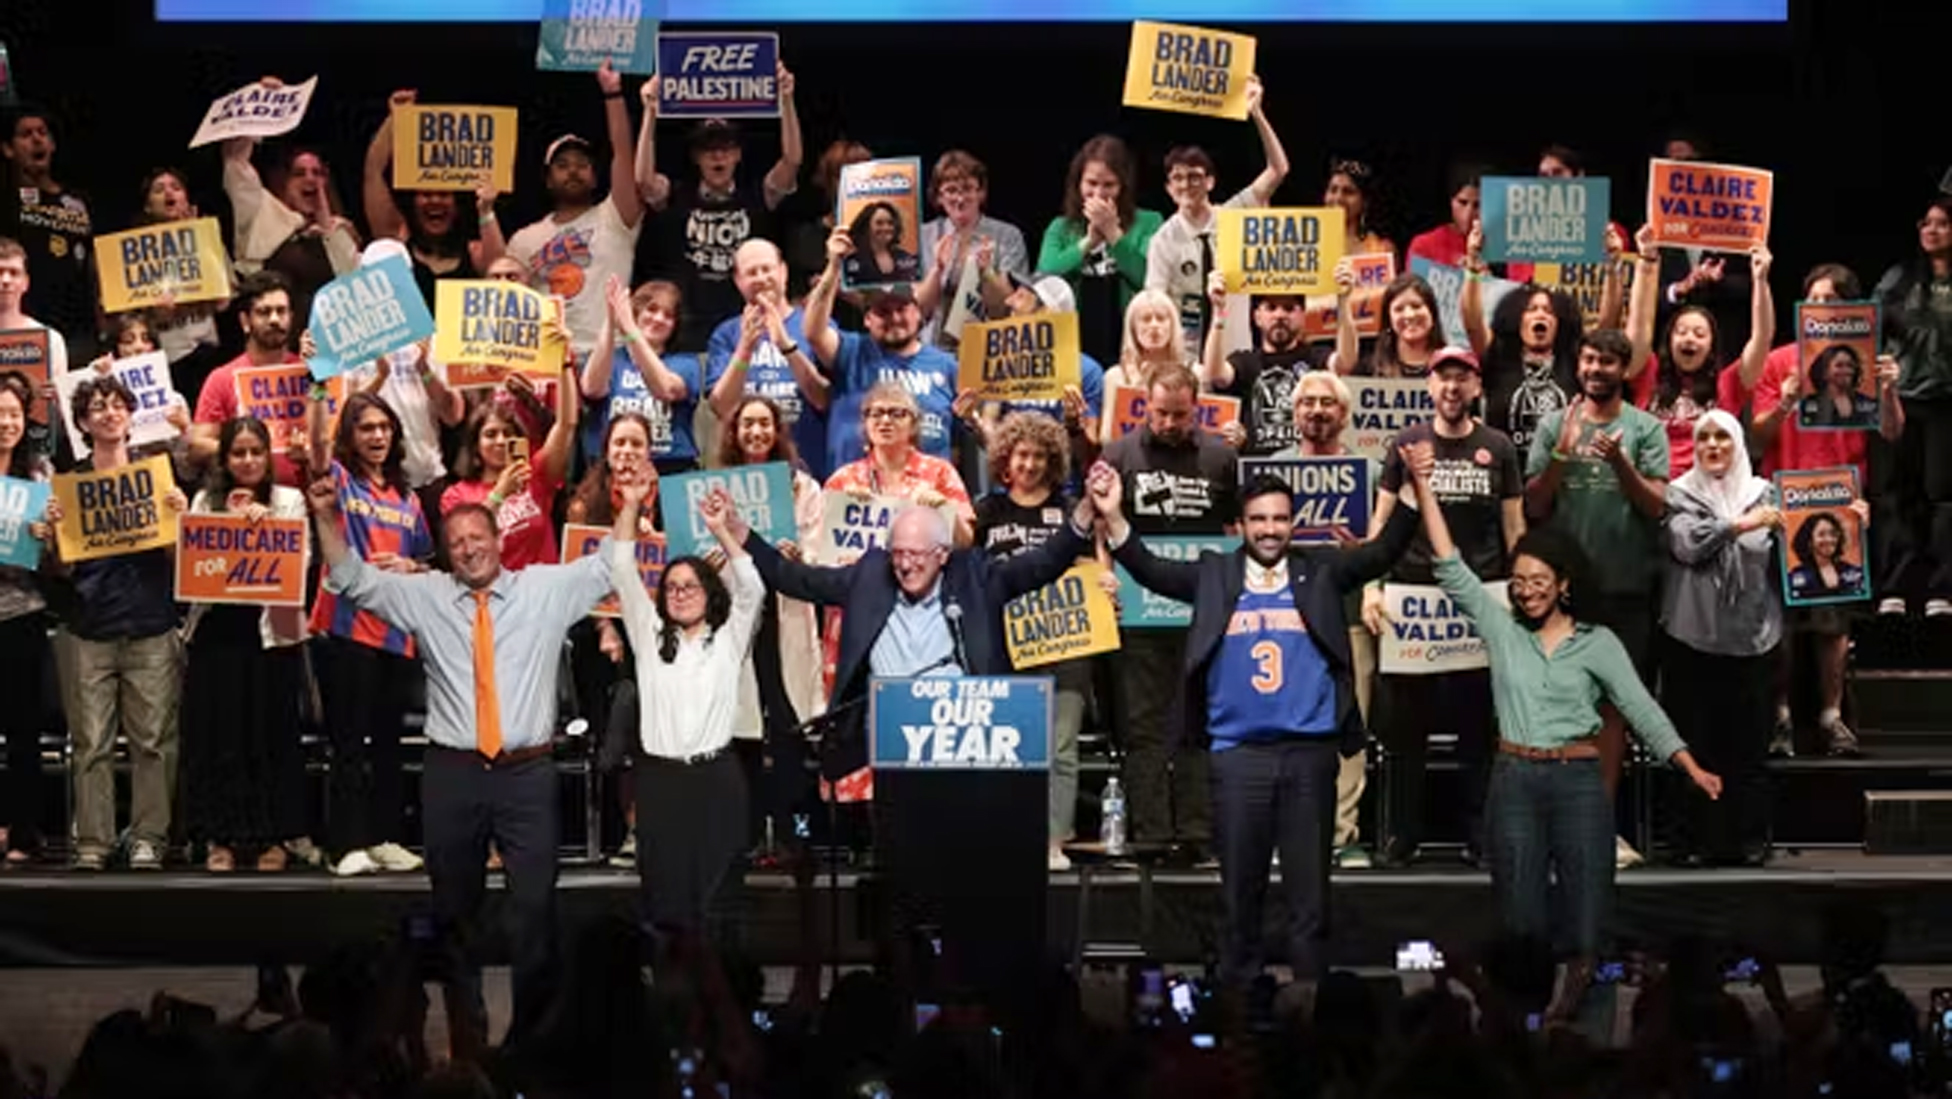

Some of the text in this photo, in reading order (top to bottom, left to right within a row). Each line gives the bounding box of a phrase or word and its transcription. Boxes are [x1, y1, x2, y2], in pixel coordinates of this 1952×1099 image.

[564, 26, 636, 54] LANDER
[1156, 31, 1232, 68] BRAD
[682, 43, 759, 73] FREE
[663, 76, 776, 101] PALESTINE
[1152, 64, 1229, 95] LANDER
[419, 112, 494, 143] BRAD
[418, 143, 493, 170] LANDER
[1507, 184, 1586, 216] BRAD
[1669, 171, 1756, 200] CLAIRE
[1659, 196, 1764, 224] VALDEZ
[1243, 216, 1320, 245] BRAD
[1507, 216, 1586, 242] LANDER
[121, 228, 197, 265] BRAD
[1242, 247, 1319, 274] LANDER
[125, 257, 203, 289] LANDER
[315, 268, 395, 328] BRAD
[463, 287, 540, 321] BRAD
[325, 299, 407, 352] LANDER
[461, 320, 539, 349] LANDER
[987, 320, 1054, 359] BRAD
[982, 353, 1055, 382] LANDER
[78, 469, 154, 511] BRAD
[81, 502, 159, 536] LANDER
[1293, 498, 1350, 526] ALL
[184, 525, 301, 553] MEDICARE
[194, 558, 282, 584] FOR ALL
[1008, 576, 1085, 619] BRAD
[1010, 608, 1091, 648] LANDER
[1250, 640, 1284, 694] 3
[911, 680, 1010, 698] OUR TEAM
[932, 699, 994, 726] OUR
[902, 725, 1022, 767] YEAR
